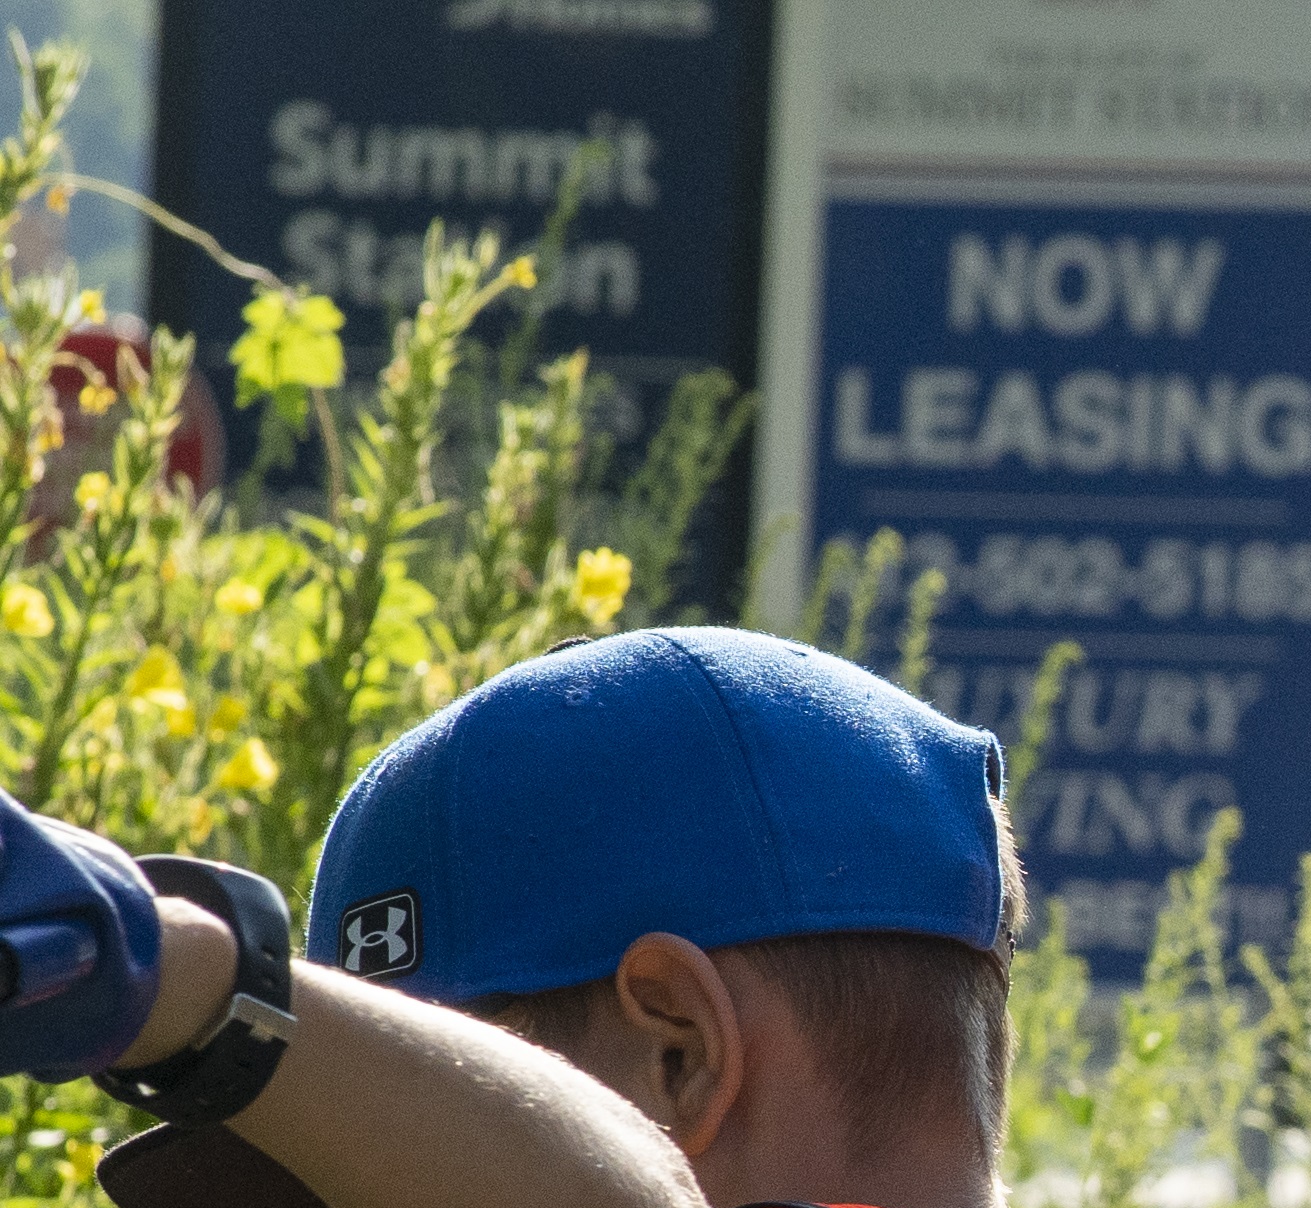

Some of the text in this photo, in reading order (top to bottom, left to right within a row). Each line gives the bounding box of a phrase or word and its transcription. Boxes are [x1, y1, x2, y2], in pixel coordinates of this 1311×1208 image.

[838, 78, 1085, 124] SUMMIT
[270, 101, 658, 207] Summit
[951, 233, 1225, 334] NOW
